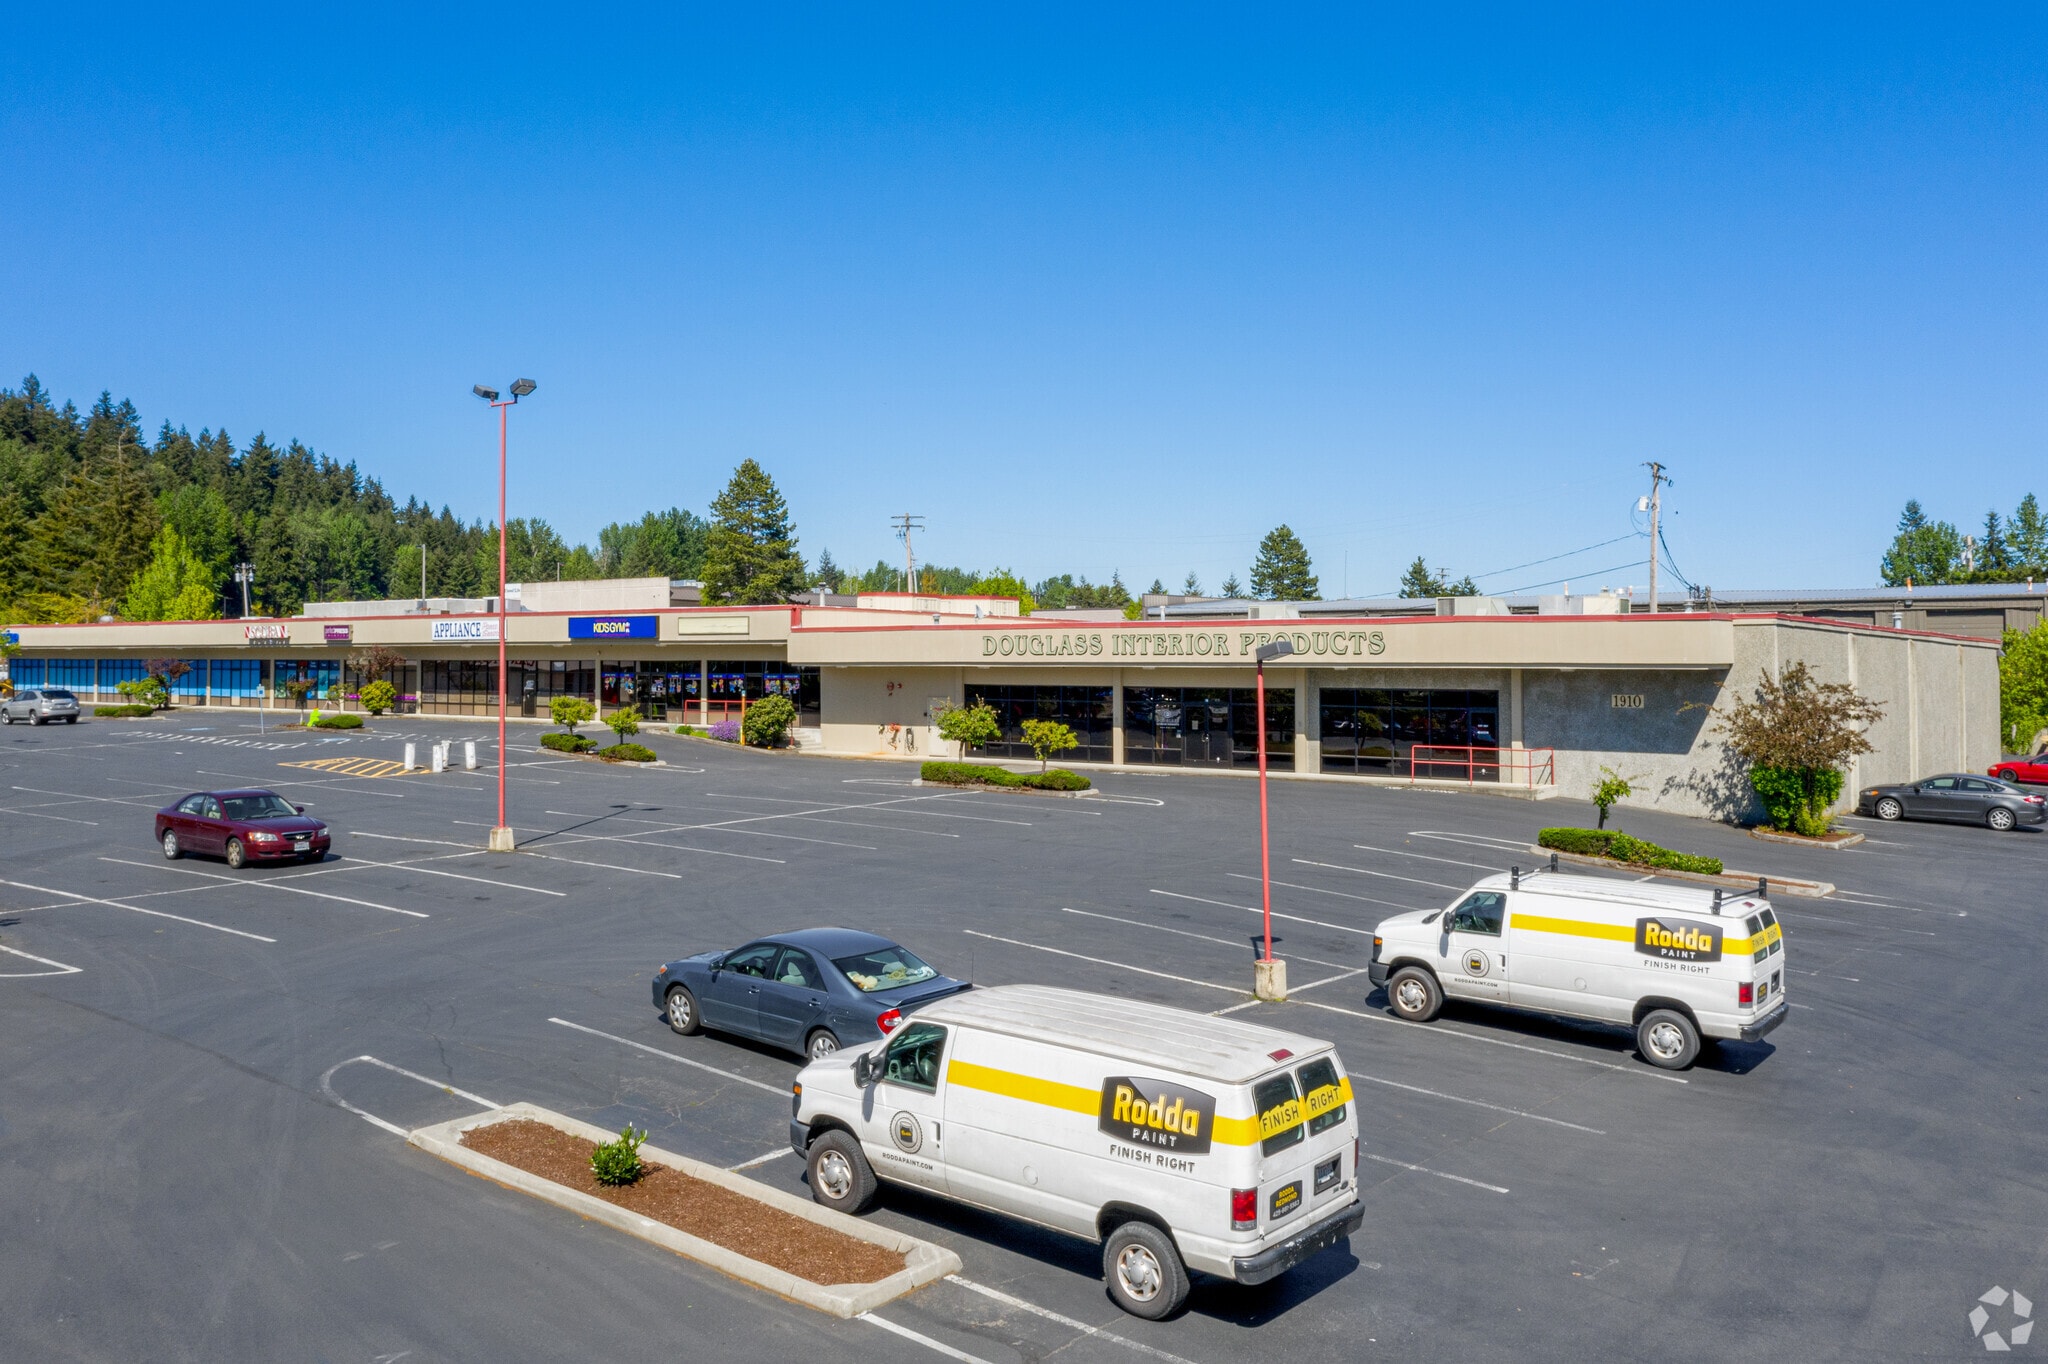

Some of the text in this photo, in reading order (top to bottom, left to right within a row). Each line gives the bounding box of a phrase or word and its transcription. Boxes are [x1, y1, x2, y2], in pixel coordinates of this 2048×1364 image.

[434, 622, 481, 638] APPLIANCE
[982, 634, 1103, 656] DOUGLASS
[1112, 633, 1230, 656] INTERIOR
[1613, 695, 1642, 708] 1910
[1645, 921, 1713, 953] Rodda
[1661, 948, 1696, 960] PAINT
[1643, 960, 1710, 975] FINISH RIGHT
[1113, 1084, 1200, 1137] Rodda
[1262, 1087, 1339, 1132] FINISH RIGHT
[1132, 1128, 1177, 1147] PAINT
[882, 1152, 933, 1170] RODDAPAINT.COM
[1110, 1144, 1195, 1173] FINISH RIGHT
